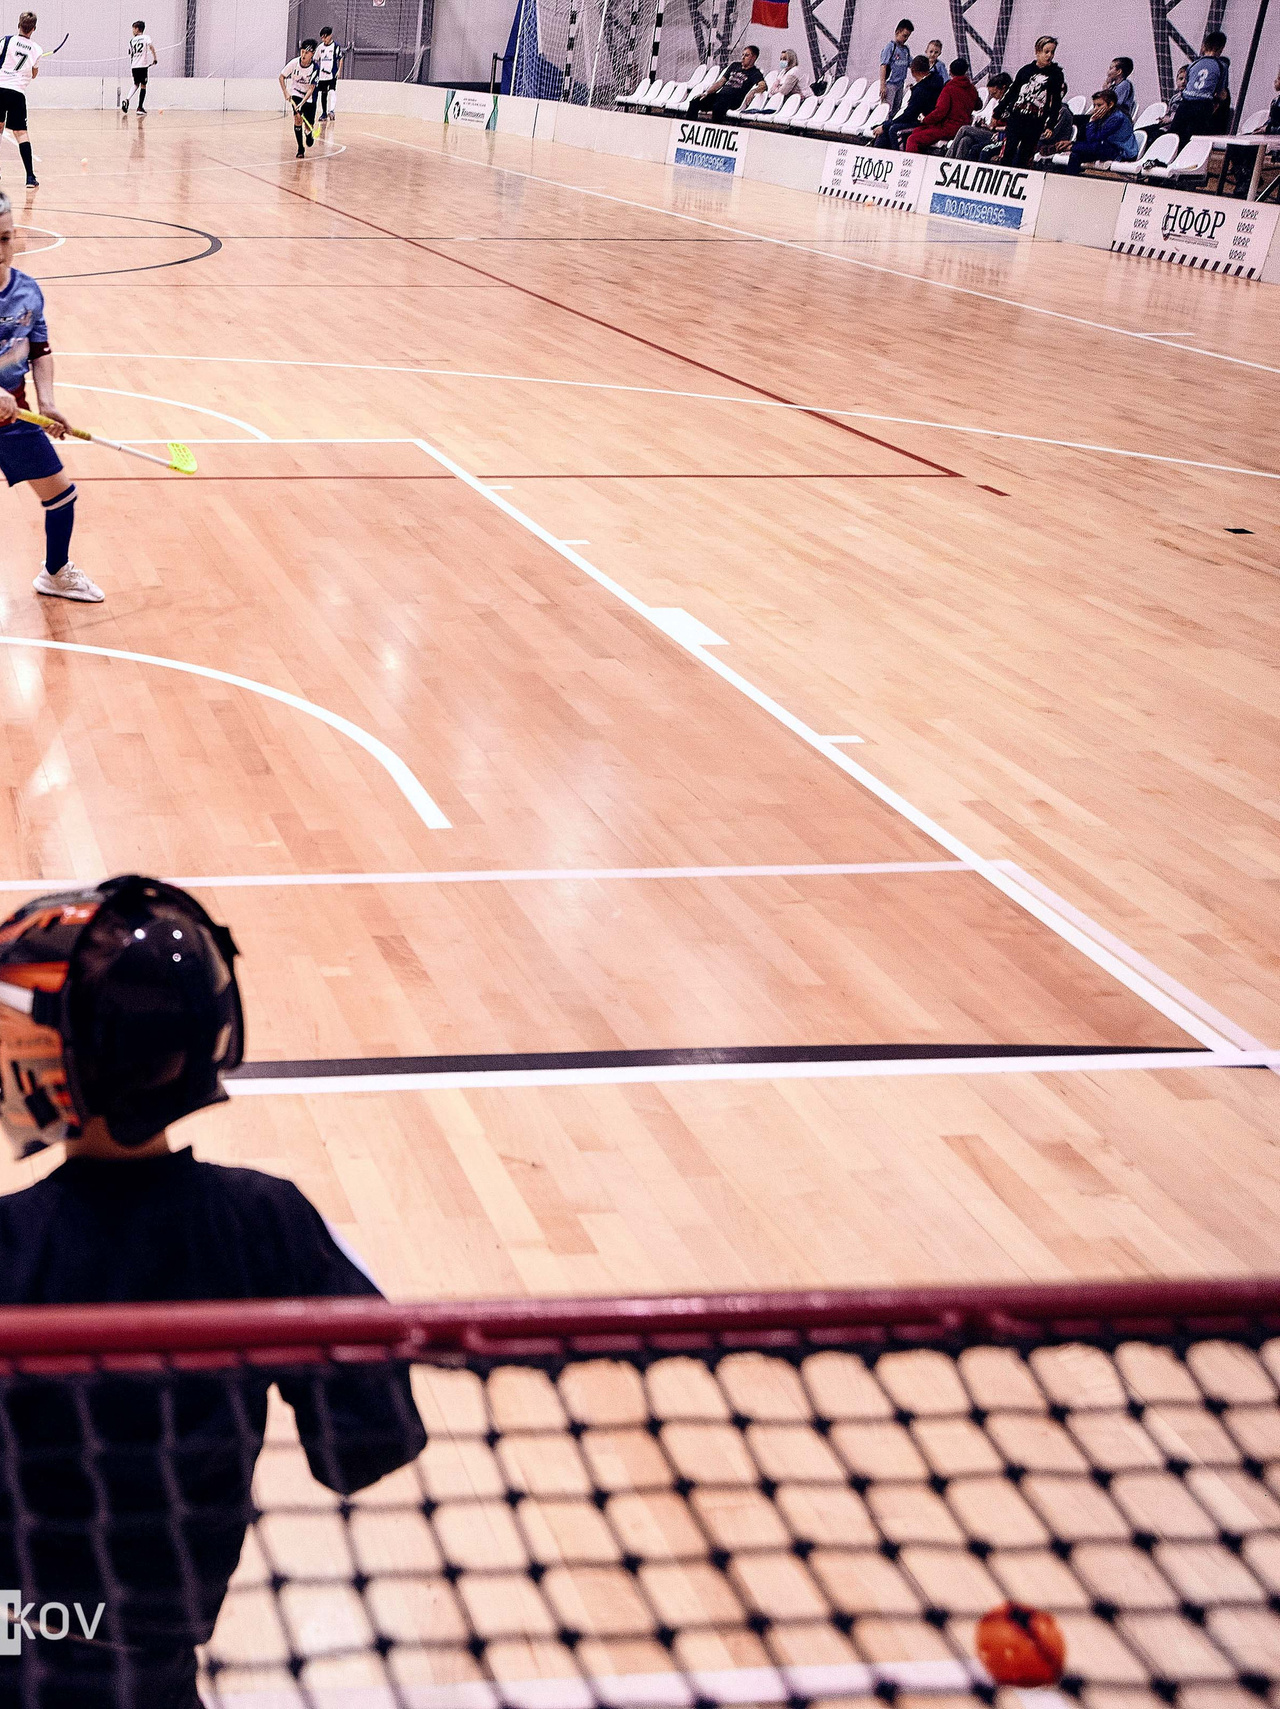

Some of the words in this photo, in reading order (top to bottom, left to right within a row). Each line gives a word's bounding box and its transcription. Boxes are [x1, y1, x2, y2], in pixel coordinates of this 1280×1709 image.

[133, 43, 144, 54] 12
[14, 51, 28, 71] 7
[1194, 68, 1209, 89] 3
[851, 156, 894, 183] НФФР
[935, 161, 1029, 201] SALMING.
[1162, 203, 1226, 240] НФФР
